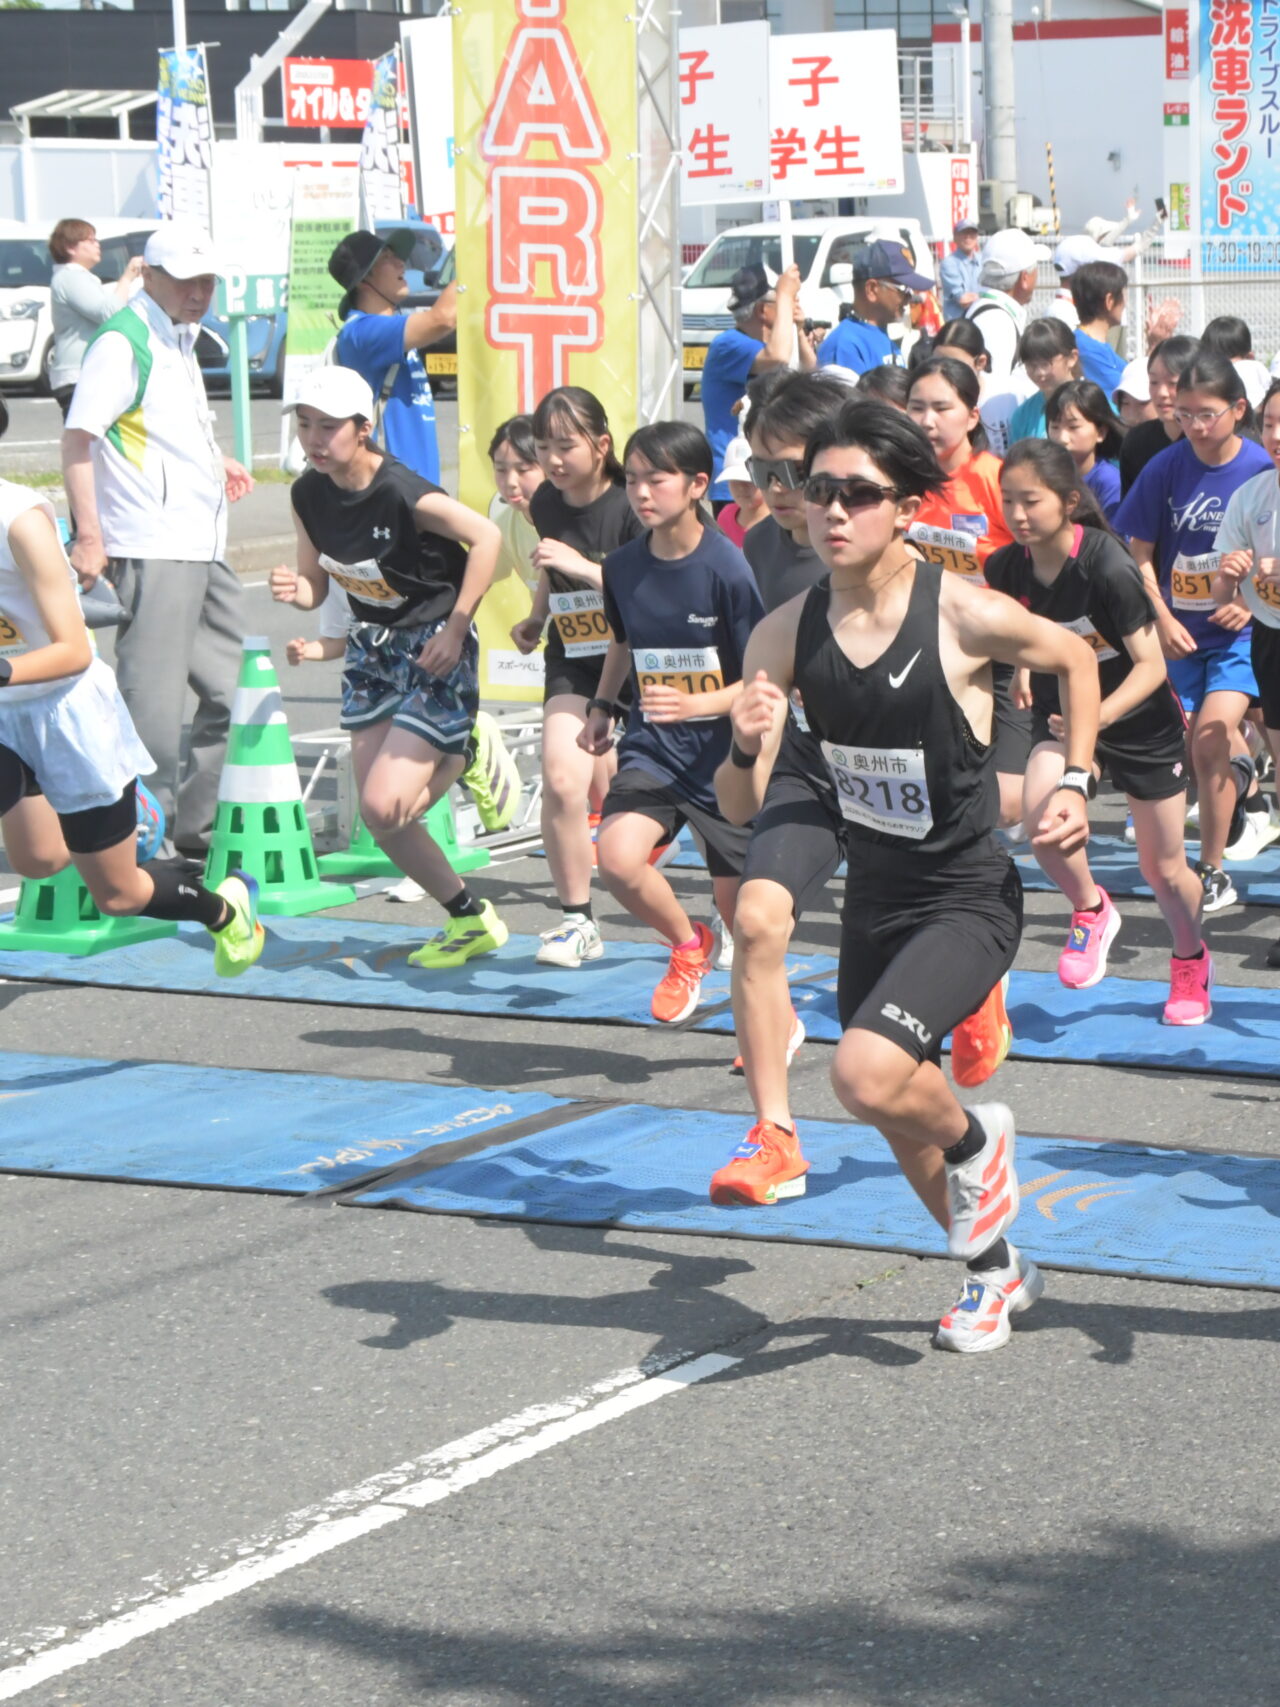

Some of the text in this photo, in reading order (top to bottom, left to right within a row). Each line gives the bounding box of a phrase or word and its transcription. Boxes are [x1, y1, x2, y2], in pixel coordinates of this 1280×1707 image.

[788, 55, 839, 107] 子
[1211, 0, 1251, 226] 洗車ランド
[771, 125, 864, 180] 学生
[483, 0, 610, 413] ART
[1173, 572, 1211, 595] 851
[558, 611, 609, 638] 850
[664, 653, 706, 669] 奥州市
[853, 753, 908, 774] 奥州市
[834, 767, 925, 814] 8218
[881, 1002, 932, 1044] 2XU
